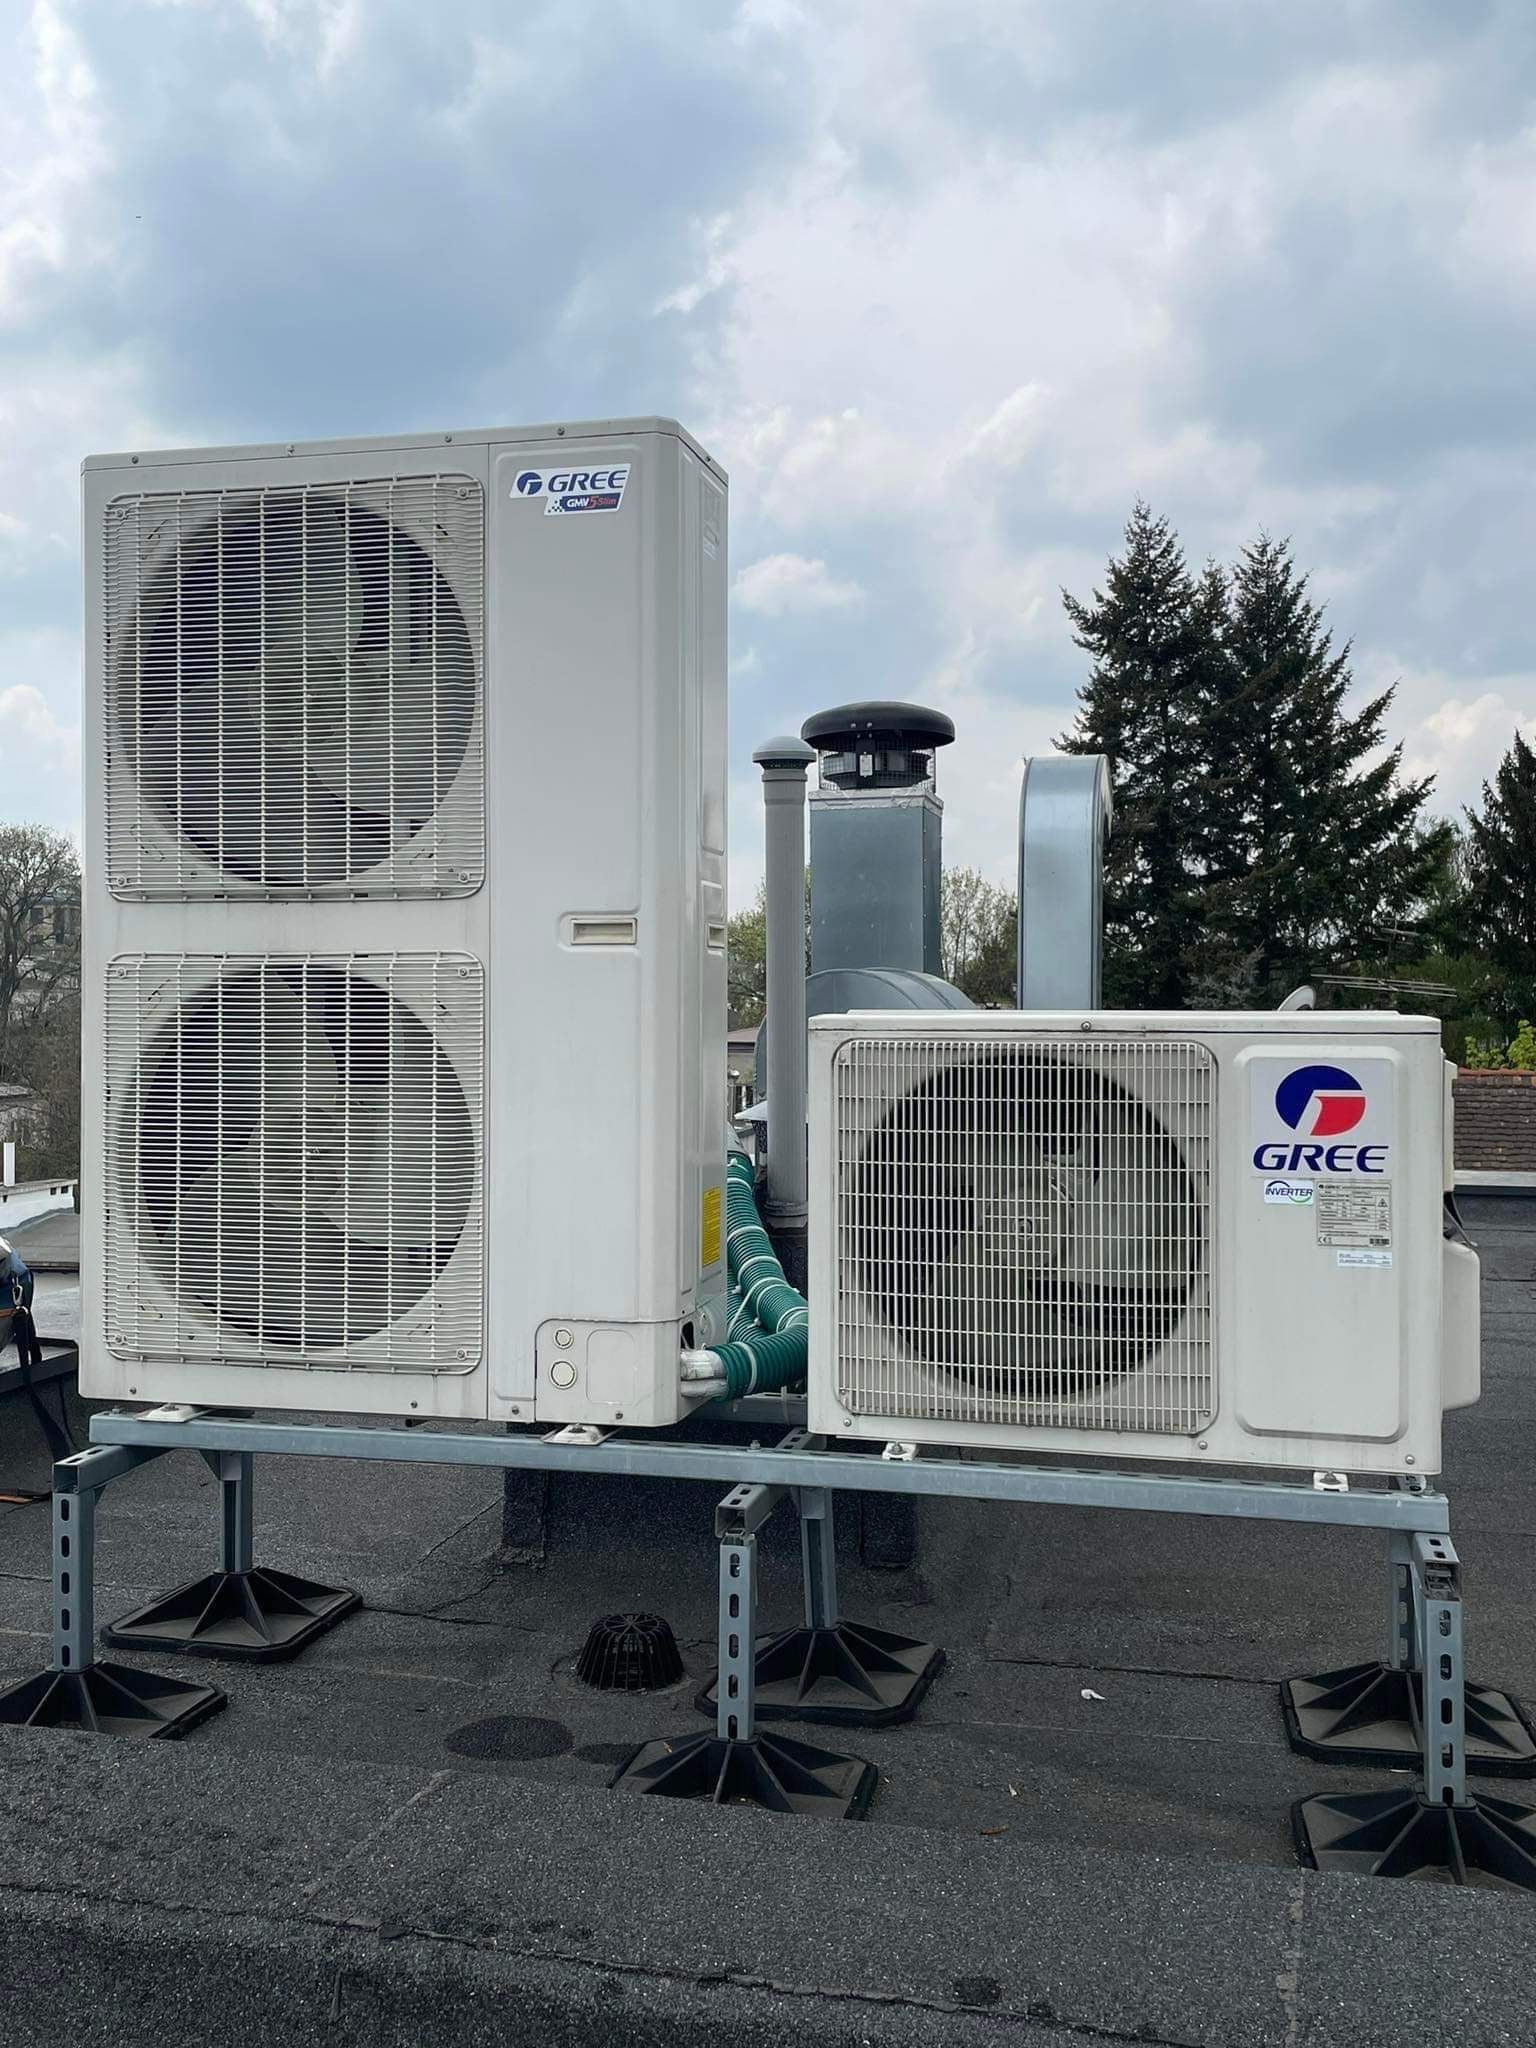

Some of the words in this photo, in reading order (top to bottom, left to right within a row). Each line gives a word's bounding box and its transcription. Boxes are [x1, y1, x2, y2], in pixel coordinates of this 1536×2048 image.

[548, 470, 627, 493] GREE
[1253, 1144, 1389, 1173] GREE
[1265, 1188, 1313, 1196] INVERTER
